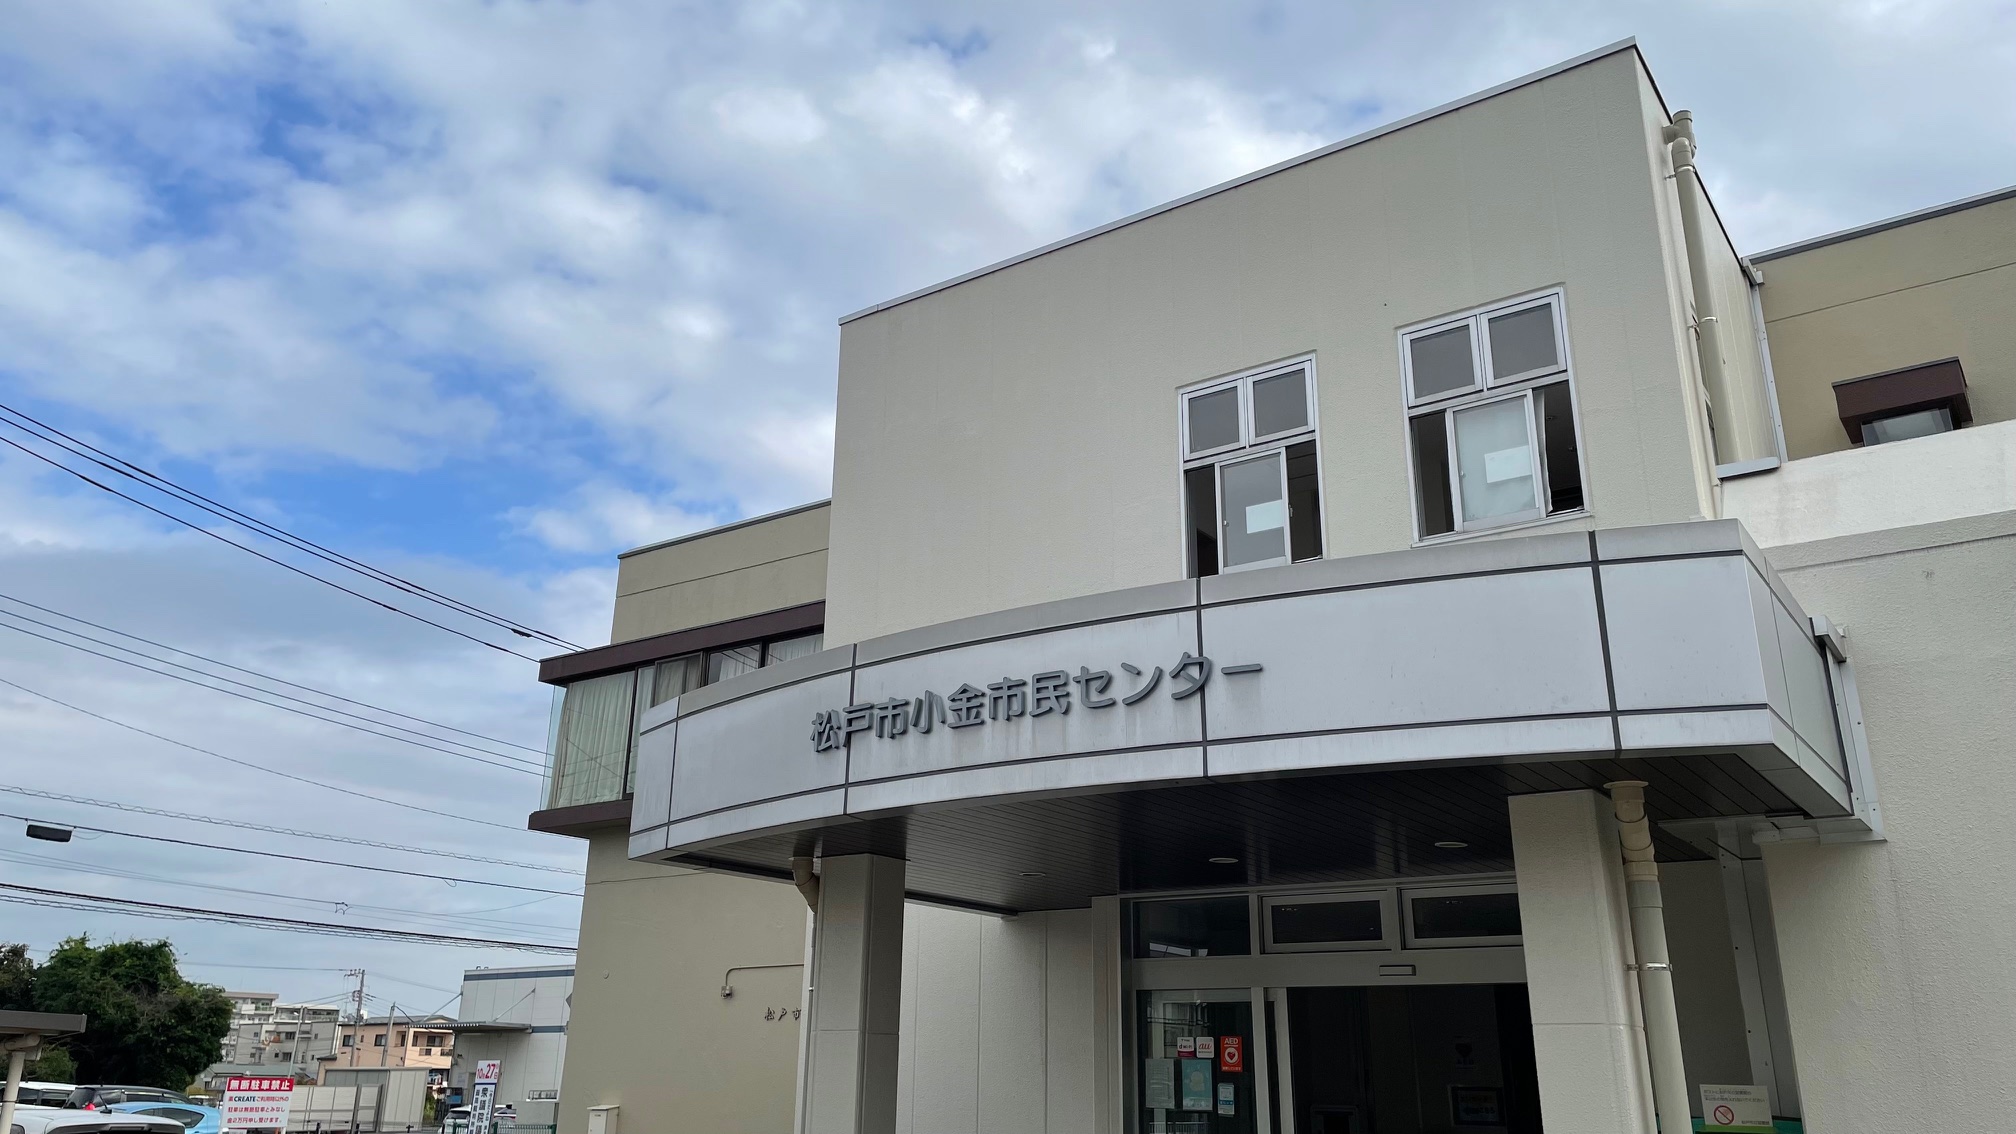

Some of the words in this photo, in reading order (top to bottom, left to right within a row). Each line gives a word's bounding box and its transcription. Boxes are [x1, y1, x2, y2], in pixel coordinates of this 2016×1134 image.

[810, 651, 1263, 753] 松戸市小金市民センター
[229, 1080, 290, 1090] 無断駐車禁止
